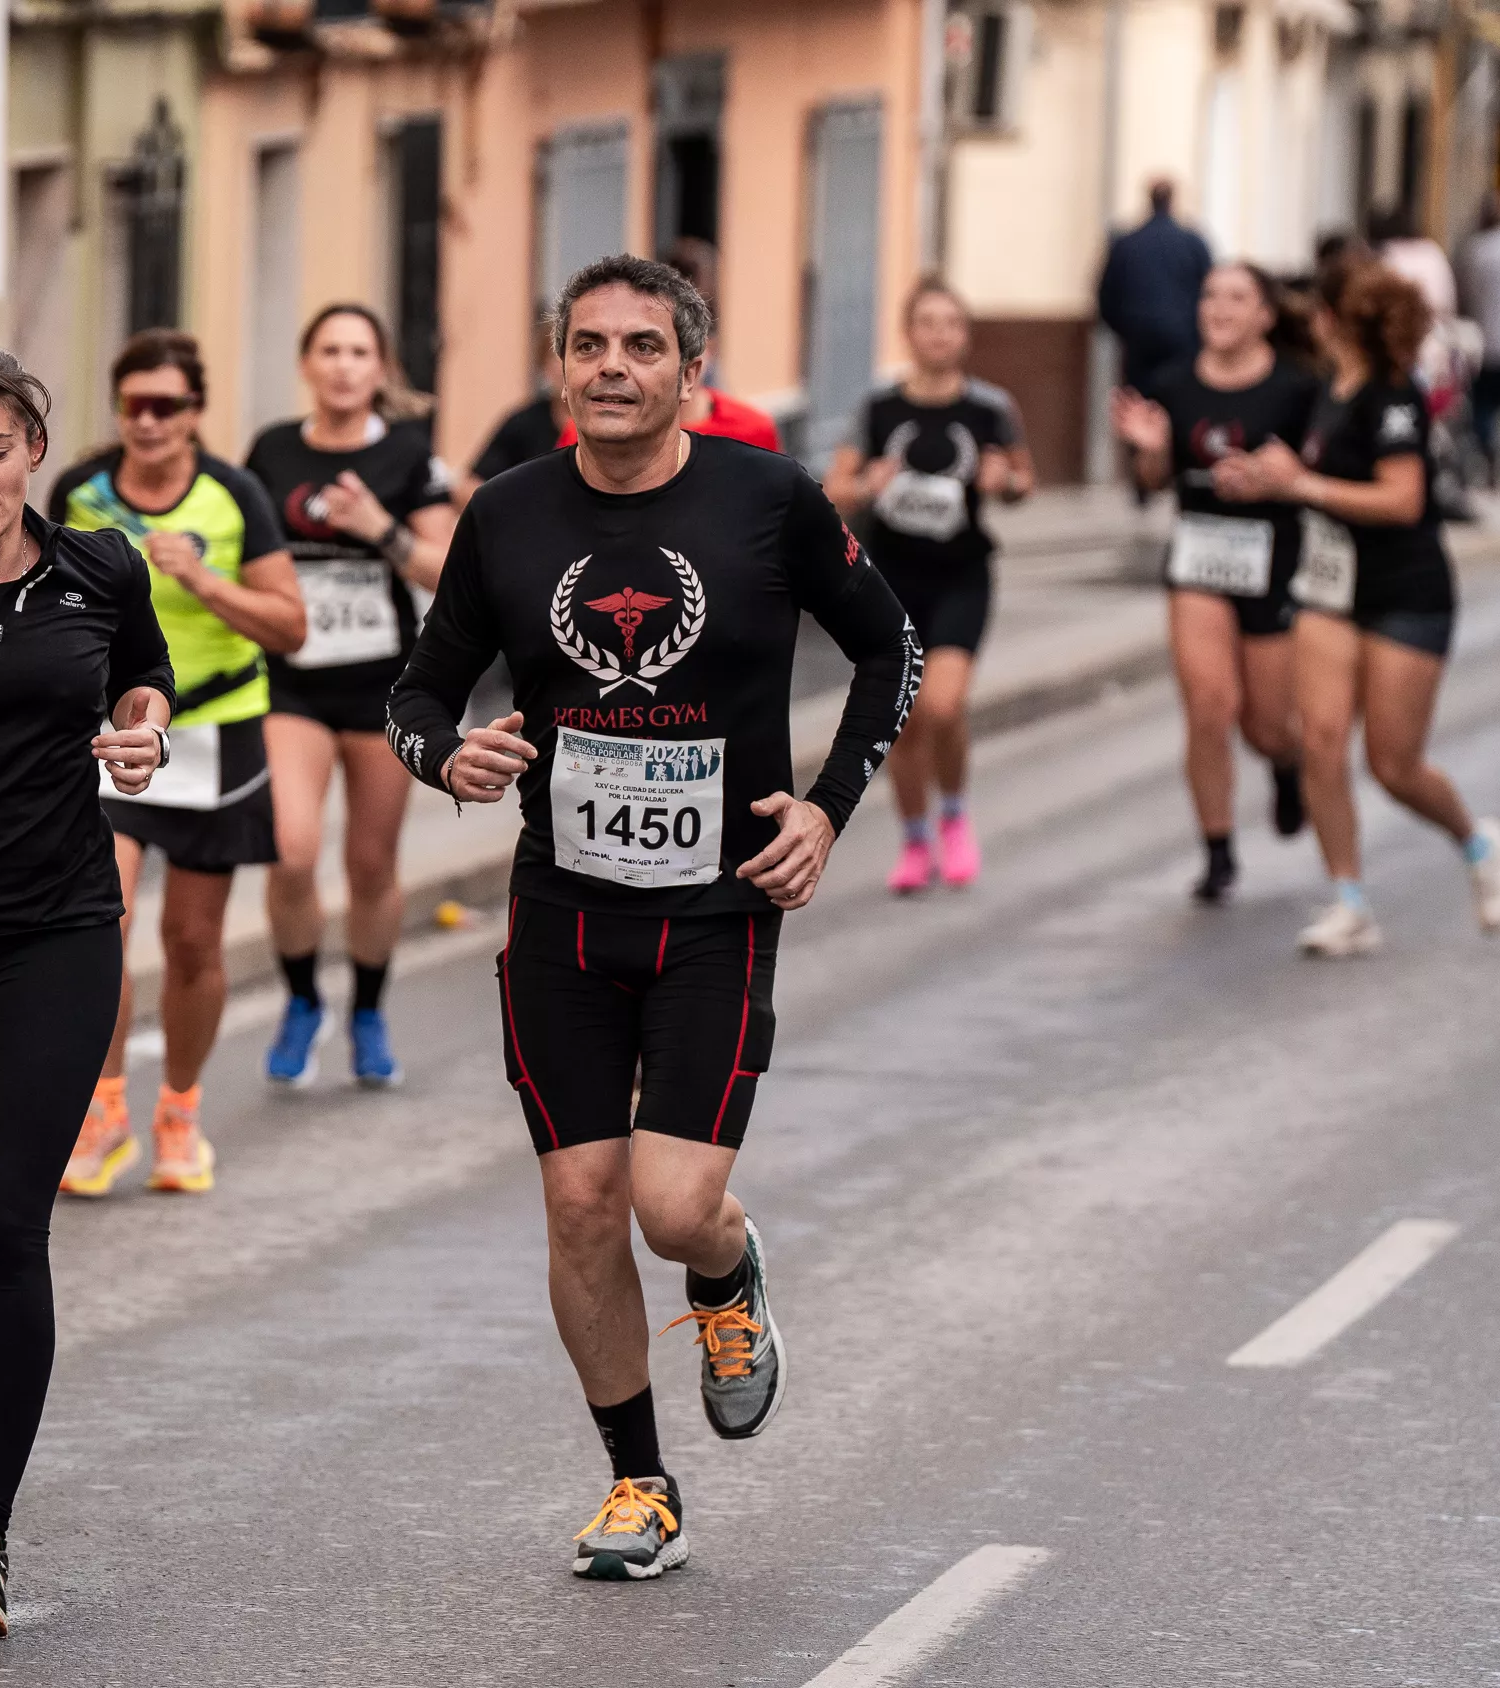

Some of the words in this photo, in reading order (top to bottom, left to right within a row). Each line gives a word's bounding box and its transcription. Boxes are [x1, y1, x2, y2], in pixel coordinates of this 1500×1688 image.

[894, 689, 906, 711] CROSS
[552, 706, 644, 729] HERMES
[649, 701, 708, 727] GYM
[562, 740, 596, 756] CARRERAS
[598, 749, 643, 760] POPULARES
[590, 740, 632, 752] PROVINCIAL
[634, 745, 643, 753] DE
[645, 745, 690, 763] 2024
[594, 781, 609, 789] XXV
[609, 783, 621, 791] C.P.
[622, 785, 647, 794] CIUDAD
[657, 787, 684, 795] LUCENA
[608, 792, 621, 800] POR
[622, 793, 632, 801] LA
[632, 795, 667, 803] IGUALDAD
[577, 800, 701, 850] 1450
